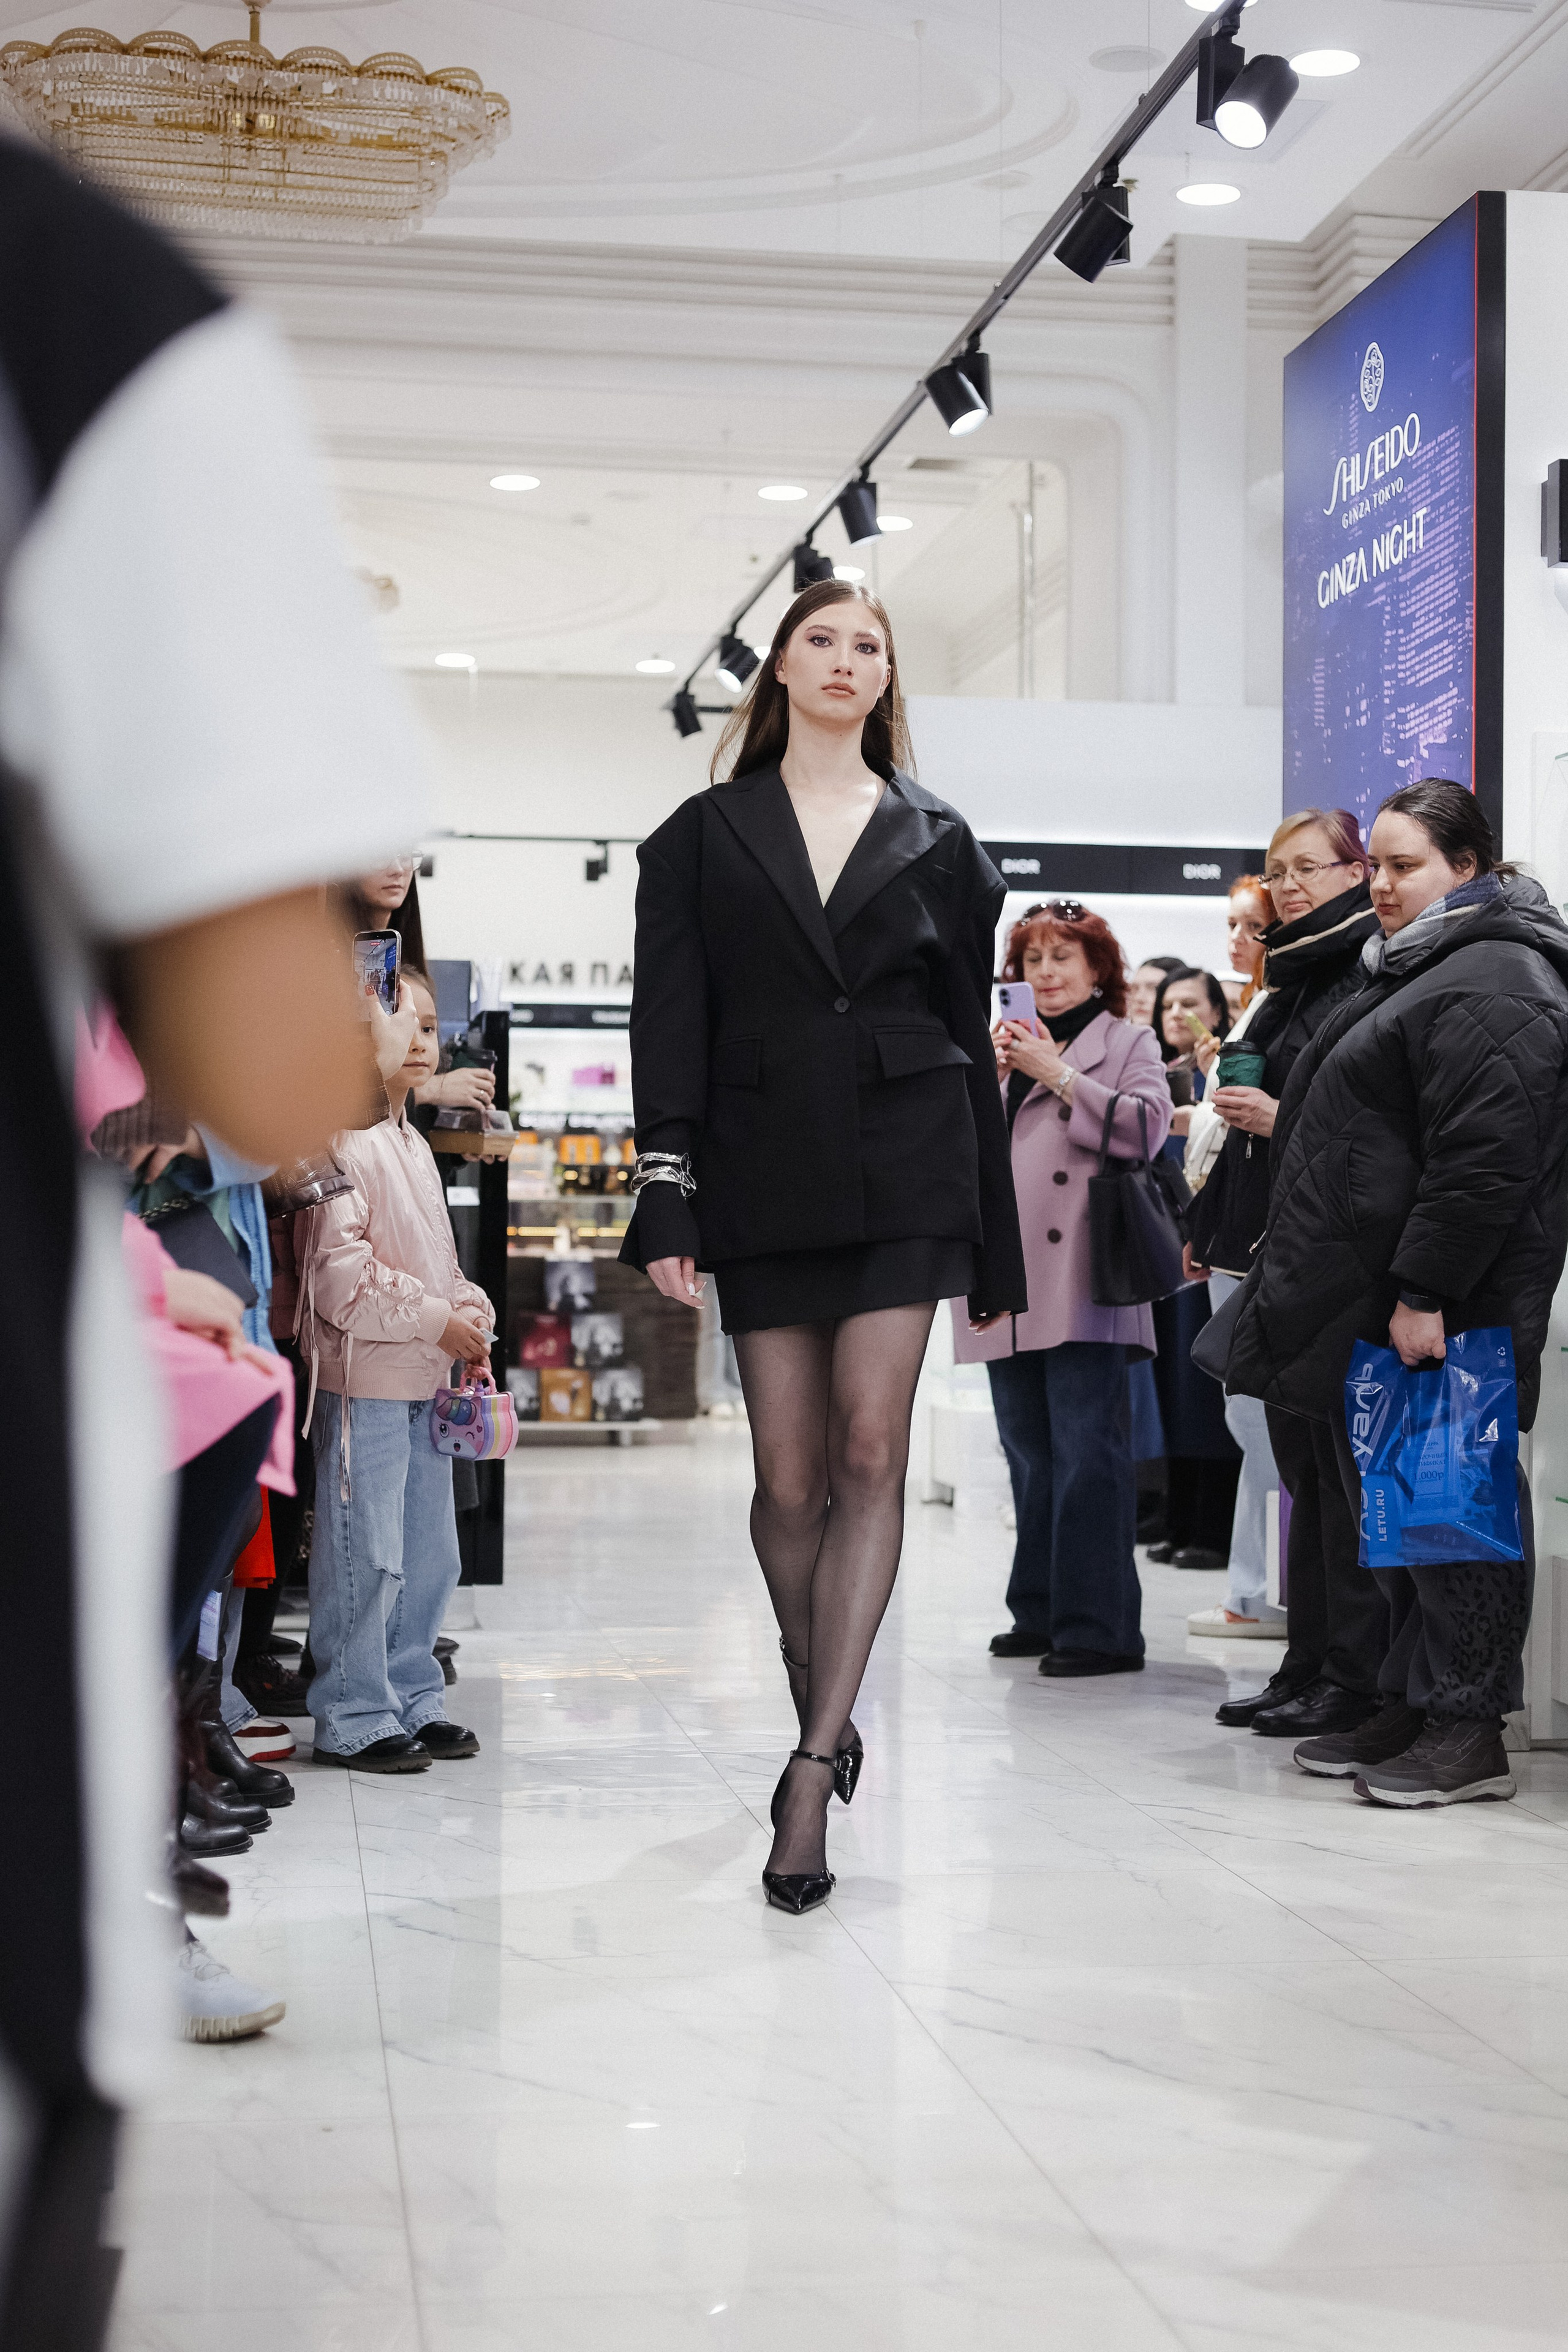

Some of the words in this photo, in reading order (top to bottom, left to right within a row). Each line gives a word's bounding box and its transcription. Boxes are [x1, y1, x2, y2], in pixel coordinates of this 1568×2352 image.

[1323, 412, 1420, 516] SHISEIDO
[1341, 498, 1371, 529] GINZA
[1372, 476, 1404, 509] TOKYO
[1317, 546, 1368, 609] GINZA
[1372, 507, 1427, 578] NIGHT
[1376, 1489, 1387, 1542] LETU.RU
